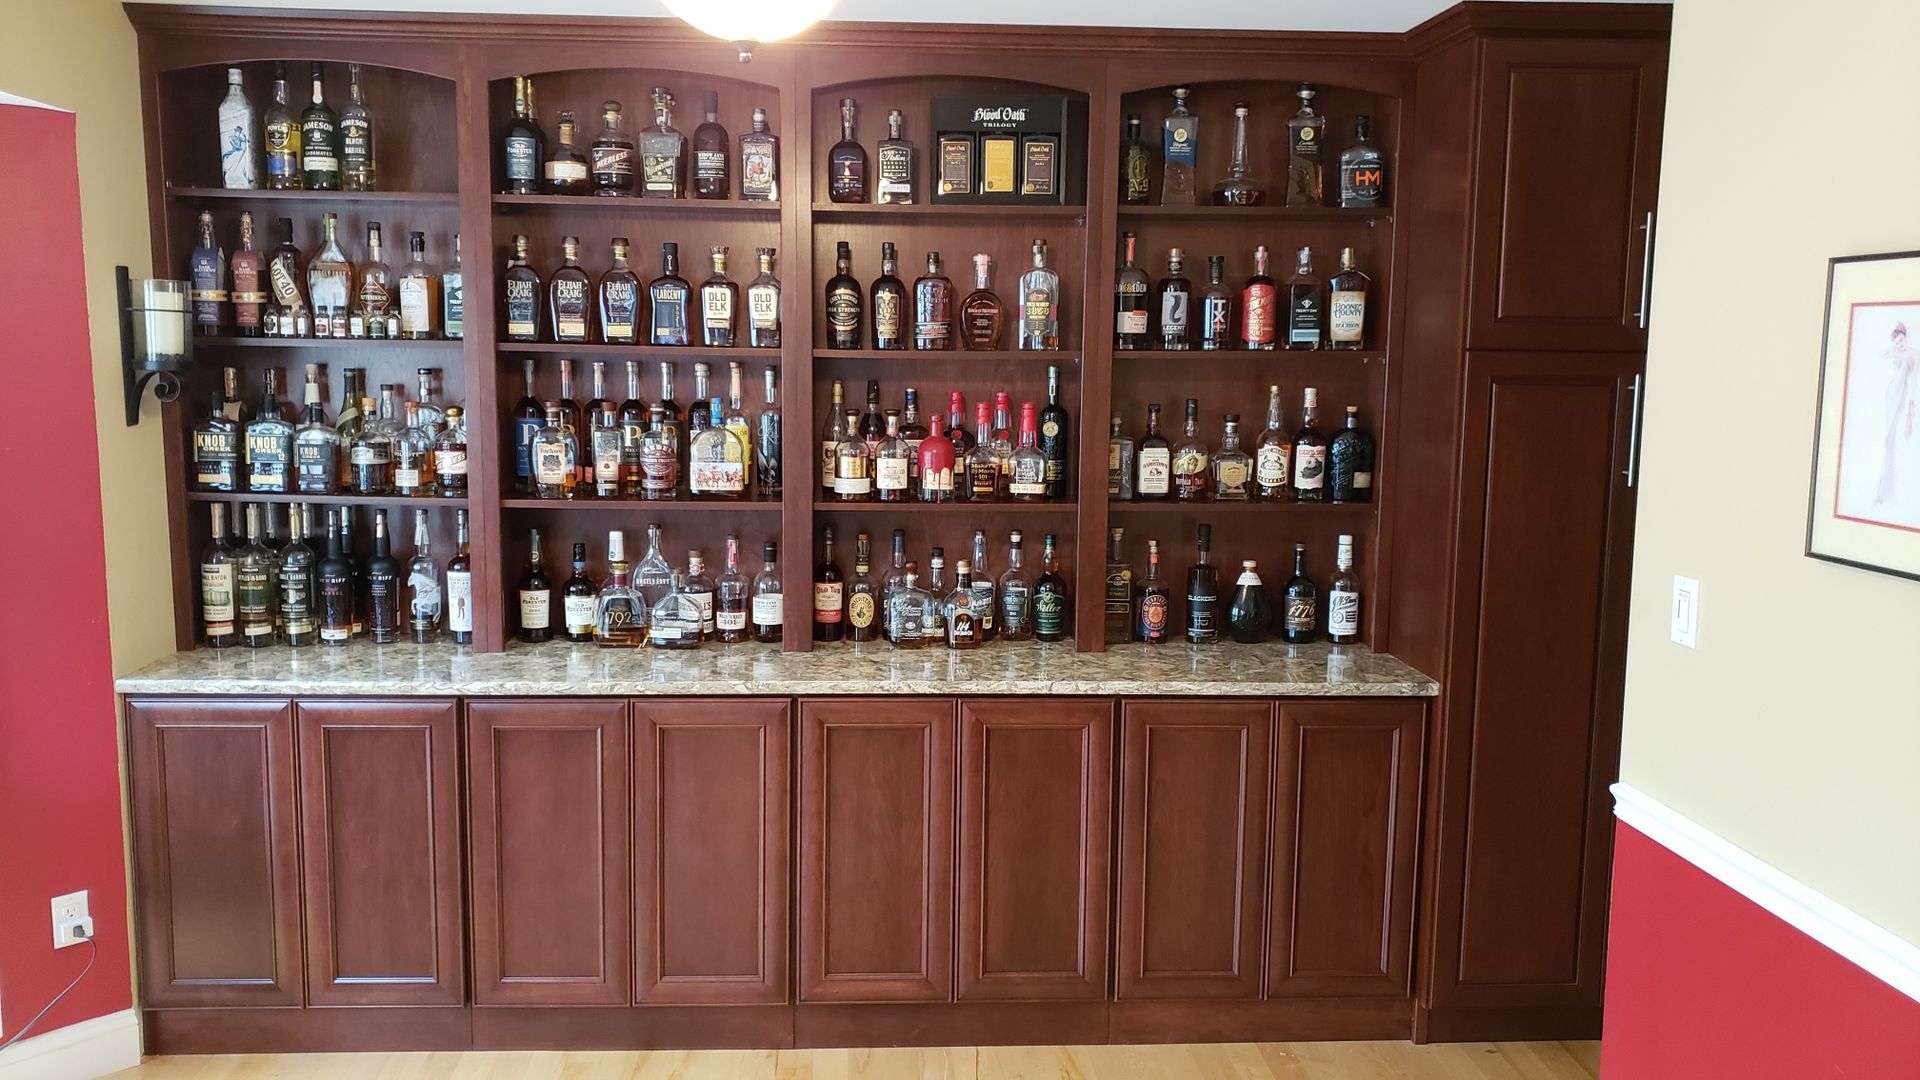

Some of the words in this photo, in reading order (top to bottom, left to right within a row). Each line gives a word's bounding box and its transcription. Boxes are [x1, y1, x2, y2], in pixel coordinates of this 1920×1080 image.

[971, 107, 1001, 122] Blood
[1002, 107, 1029, 121] Oath
[303, 121, 333, 132] JAMESON
[340, 119, 368, 128] JAMESON
[596, 151, 628, 169] PEERLESS
[1355, 171, 1380, 186] HM
[271, 261, 287, 283] LOT
[280, 280, 295, 296] 40
[507, 280, 532, 289] ELIJAH
[558, 280, 583, 289] ELIJAH
[606, 281, 631, 290] ELIJAH
[1133, 283, 1147, 292] EDEN
[507, 288, 532, 298] CRAIG
[558, 288, 583, 298] CRAIG
[606, 289, 631, 299] CRAIG
[656, 289, 681, 300] LARCENY
[709, 293, 727, 302] OLD
[753, 294, 772, 303] OLD
[709, 302, 727, 311] ELK
[754, 304, 772, 312] ELK
[1334, 303, 1362, 311] BOONE
[1334, 310, 1361, 318] COUNTY
[198, 435, 226, 447] KNOB
[624, 425, 641, 447] P
[250, 436, 276, 449] KNOB
[300, 447, 318, 455] KNOB
[643, 444, 673, 455] REBEL
[816, 586, 828, 594] OLD
[830, 586, 840, 594] TUB
[1036, 602, 1061, 612] Weller
[1287, 604, 1315, 617] 1776
[604, 611, 632, 626] 1792
[956, 621, 970, 630] 114
